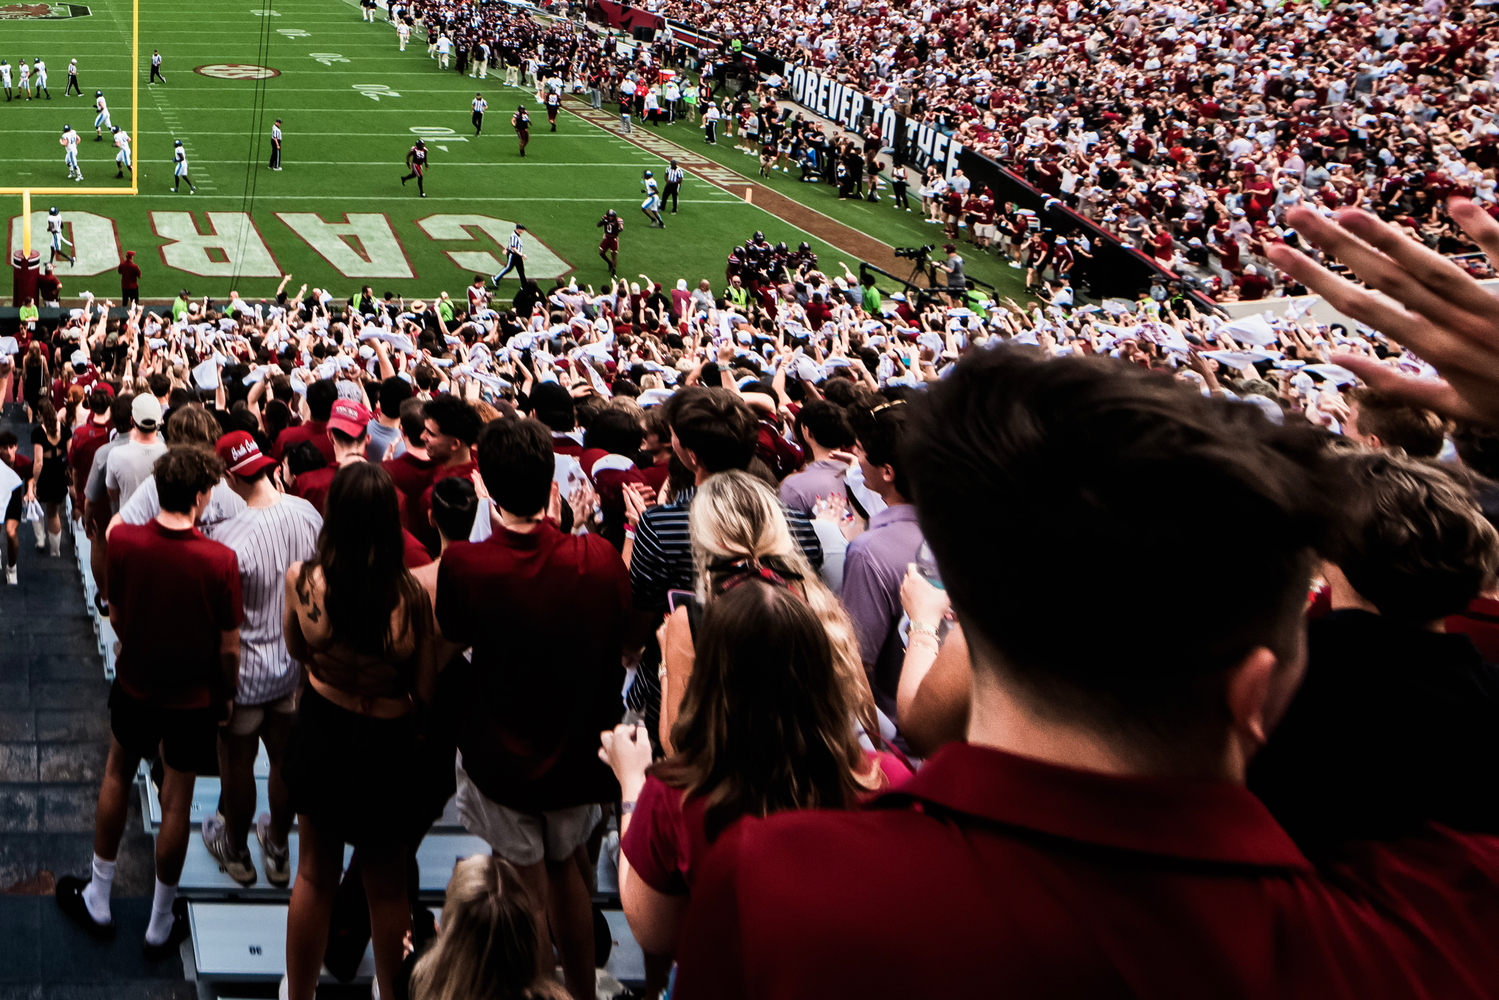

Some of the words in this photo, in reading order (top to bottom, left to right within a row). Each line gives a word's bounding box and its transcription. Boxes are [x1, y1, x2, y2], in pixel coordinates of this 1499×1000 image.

[351, 84, 402, 98] 20
[784, 61, 864, 134] FOREVER
[872, 101, 897, 148] TO
[905, 118, 964, 181] THEE
[408, 126, 470, 142] 10
[689, 166, 755, 187] THE
